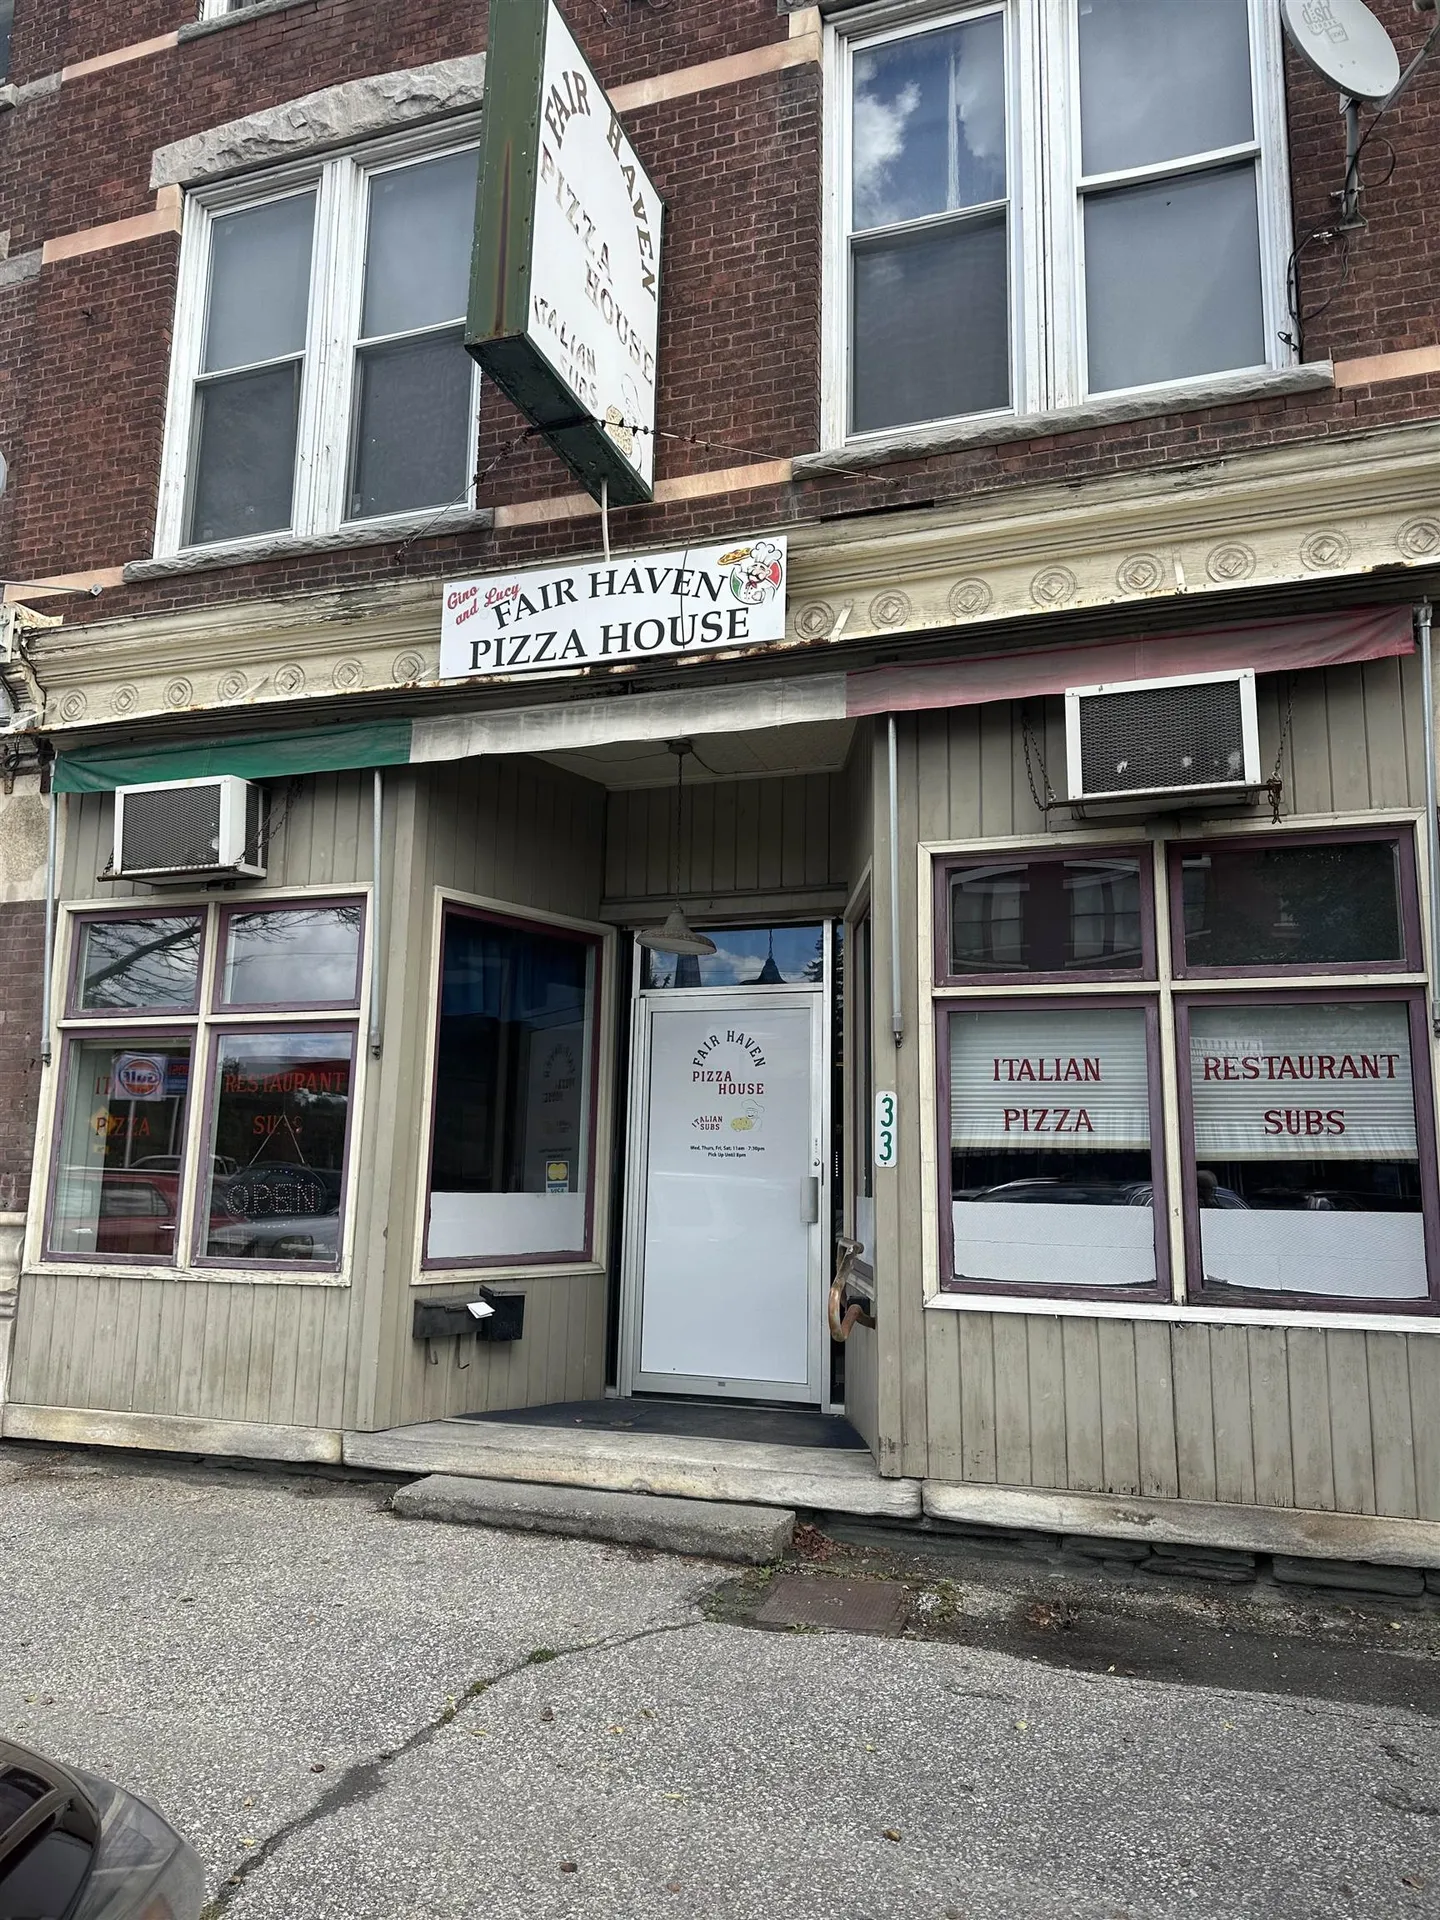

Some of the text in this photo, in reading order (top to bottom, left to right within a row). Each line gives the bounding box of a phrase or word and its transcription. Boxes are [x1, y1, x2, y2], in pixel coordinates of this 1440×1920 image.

[545, 70, 656, 302] FAIR HAVEN
[540, 141, 613, 285] PIZZA
[534, 295, 596, 376] ITALIAN
[584, 260, 655, 387] HOUSE
[447, 586, 479, 609] Gino
[455, 583, 520, 625] and Lucy
[491, 567, 728, 630] FAIR HAVEN
[468, 607, 750, 670] PIZZA HOUSE
[692, 1030, 766, 1067] FAIR HAVEN
[692, 1070, 732, 1082] PIZZA
[993, 1058, 1102, 1081] ITALIAN
[1203, 1054, 1400, 1081] RESTAURANT
[225, 1072, 346, 1093] RESTAURANT
[718, 1083, 764, 1095] HOUSE
[95, 1117, 151, 1136] PIZZA
[691, 1115, 723, 1128] ITALIAN
[700, 1123, 720, 1131] SUBS
[879, 1097, 894, 1161] 33
[1003, 1108, 1095, 1132] PIZZA
[1264, 1110, 1346, 1135] SUBS
[226, 1183, 315, 1214] OPEN
